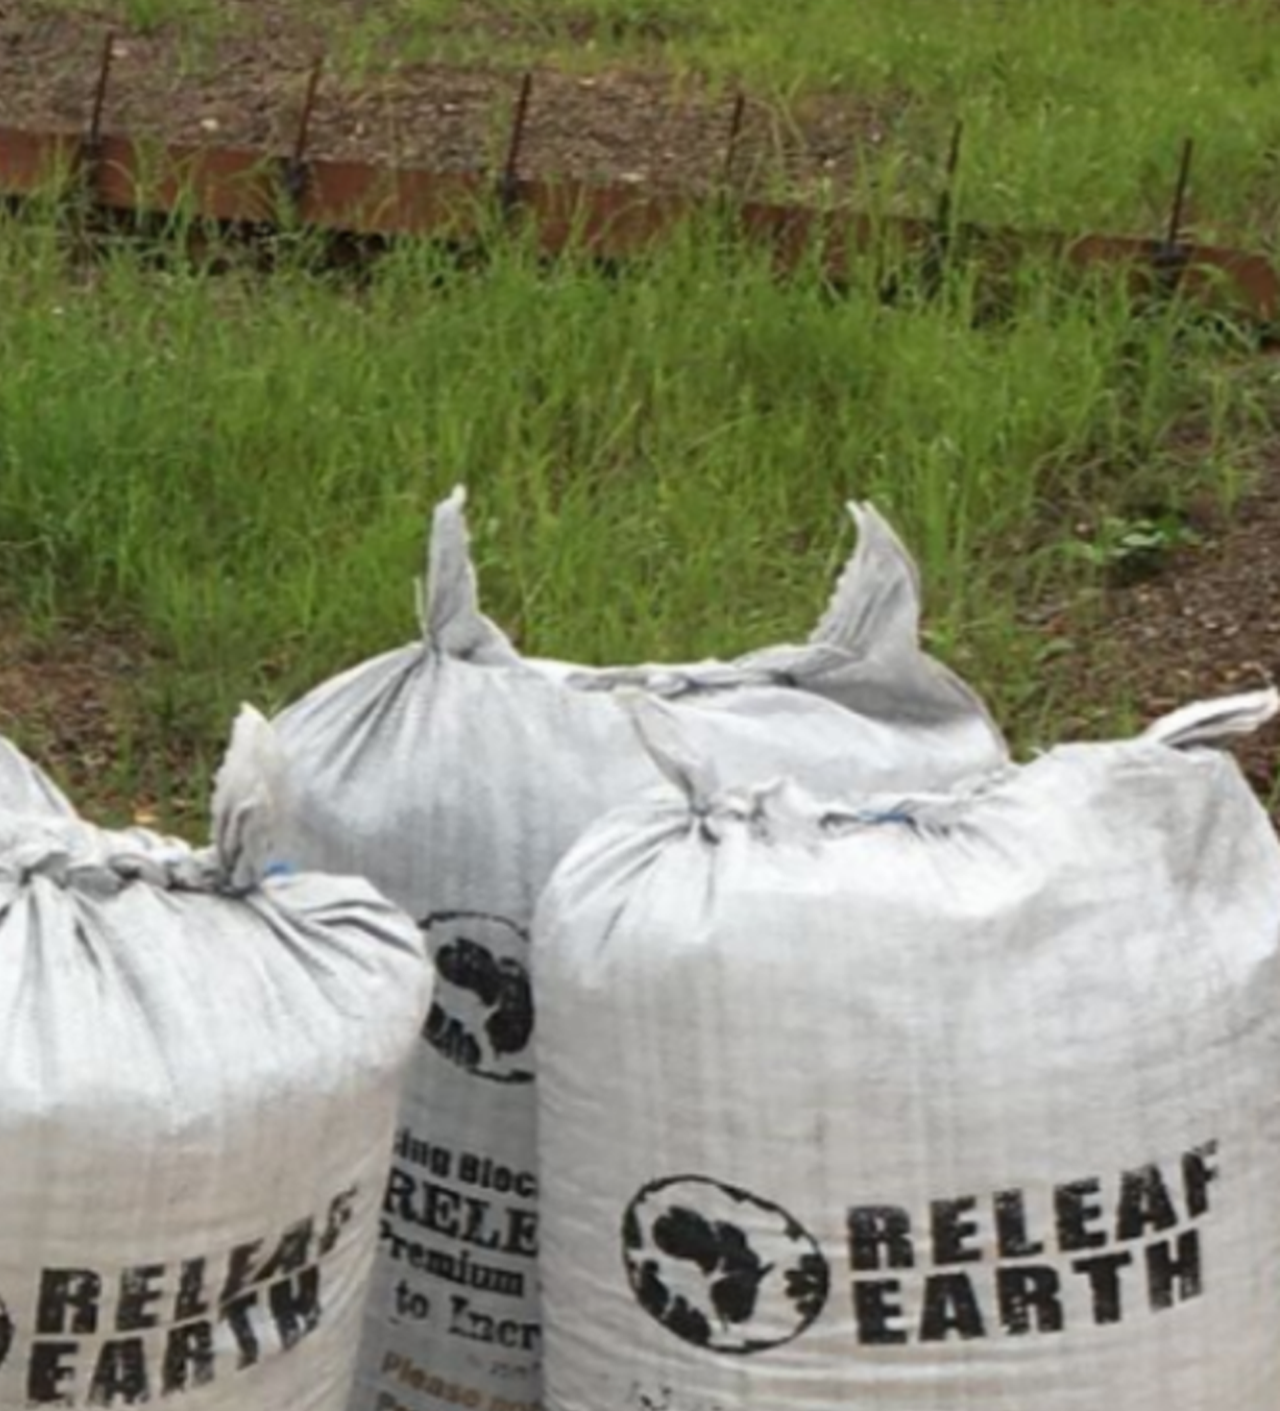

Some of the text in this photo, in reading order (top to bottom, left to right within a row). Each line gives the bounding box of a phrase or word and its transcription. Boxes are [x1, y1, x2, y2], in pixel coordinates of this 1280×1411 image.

[383, 1166, 540, 1259] RELE
[394, 1126, 539, 1198] ing Bioc
[847, 1139, 1219, 1271] RELEAF
[36, 1186, 358, 1336] RELEAF
[852, 1228, 1203, 1346] EARTH
[26, 1263, 322, 1410] EARTH
[396, 1280, 542, 1350] to Incr
[382, 1352, 482, 1409] Please
